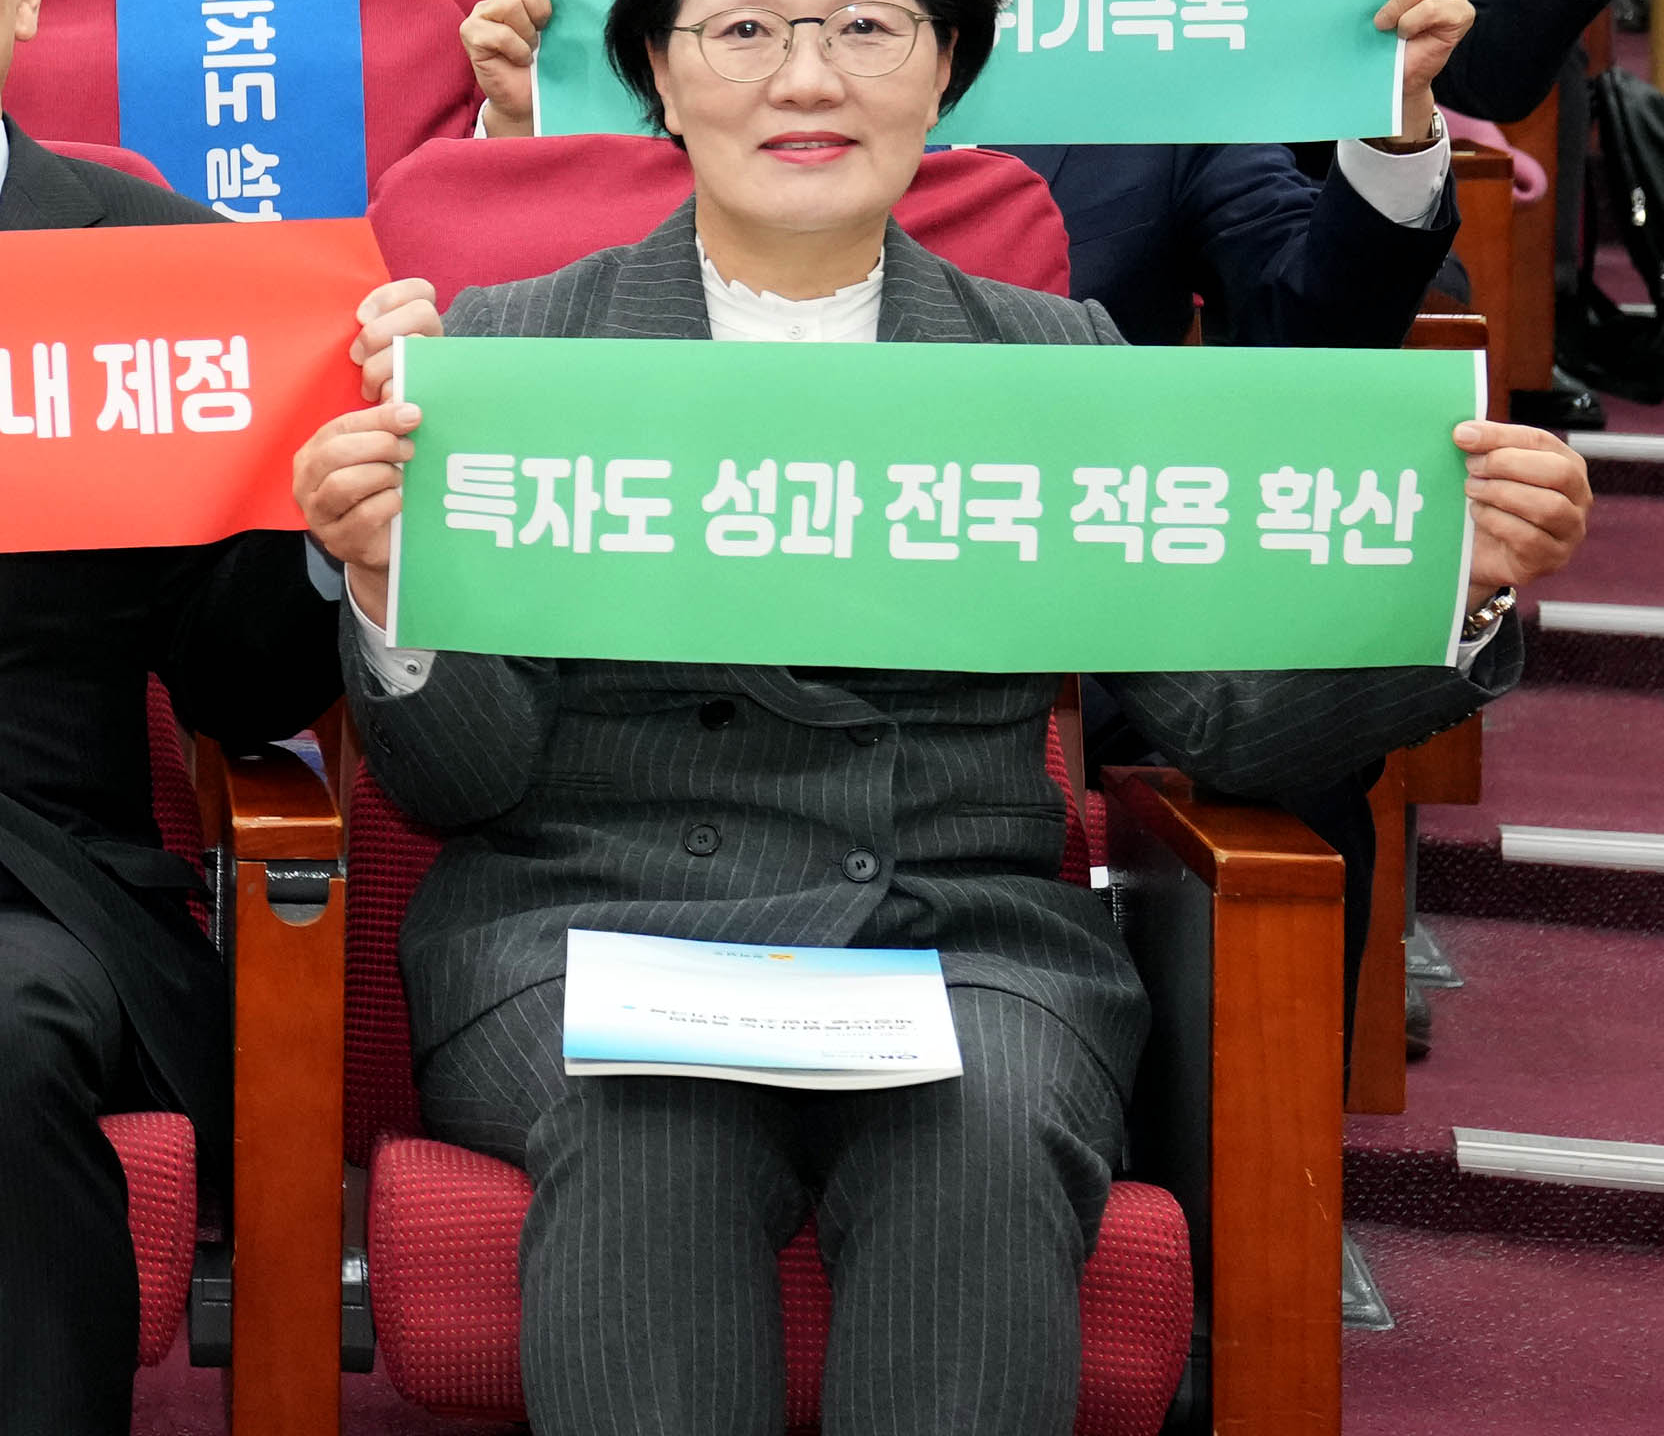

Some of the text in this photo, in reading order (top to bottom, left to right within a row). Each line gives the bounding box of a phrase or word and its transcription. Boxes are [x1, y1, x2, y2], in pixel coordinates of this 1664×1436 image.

[93, 335, 254, 435] 제정
[444, 452, 1423, 567] 특자도 성과 전국 적용 확산
